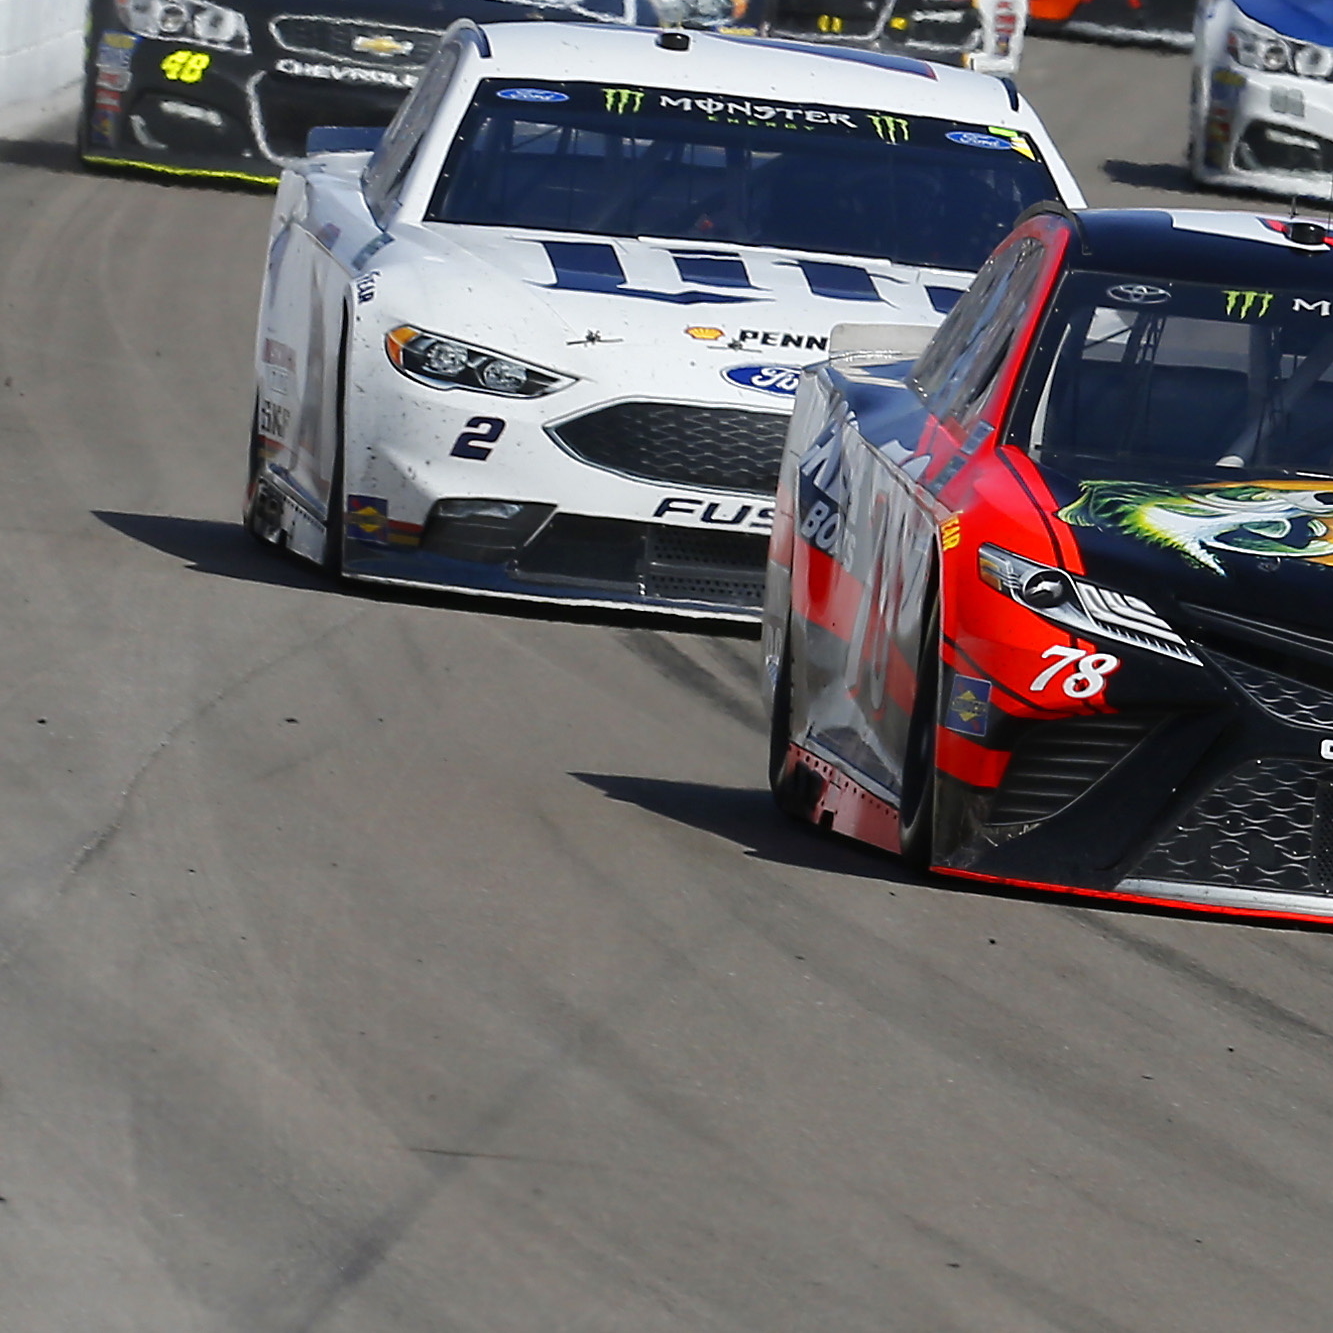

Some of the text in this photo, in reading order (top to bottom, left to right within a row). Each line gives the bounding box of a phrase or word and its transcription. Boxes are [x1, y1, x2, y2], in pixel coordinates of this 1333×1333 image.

[161, 50, 211, 84] 48
[659, 94, 859, 129] MONSTER
[738, 329, 829, 352] PENN
[449, 416, 506, 461] 2
[1029, 644, 1120, 699] 78
